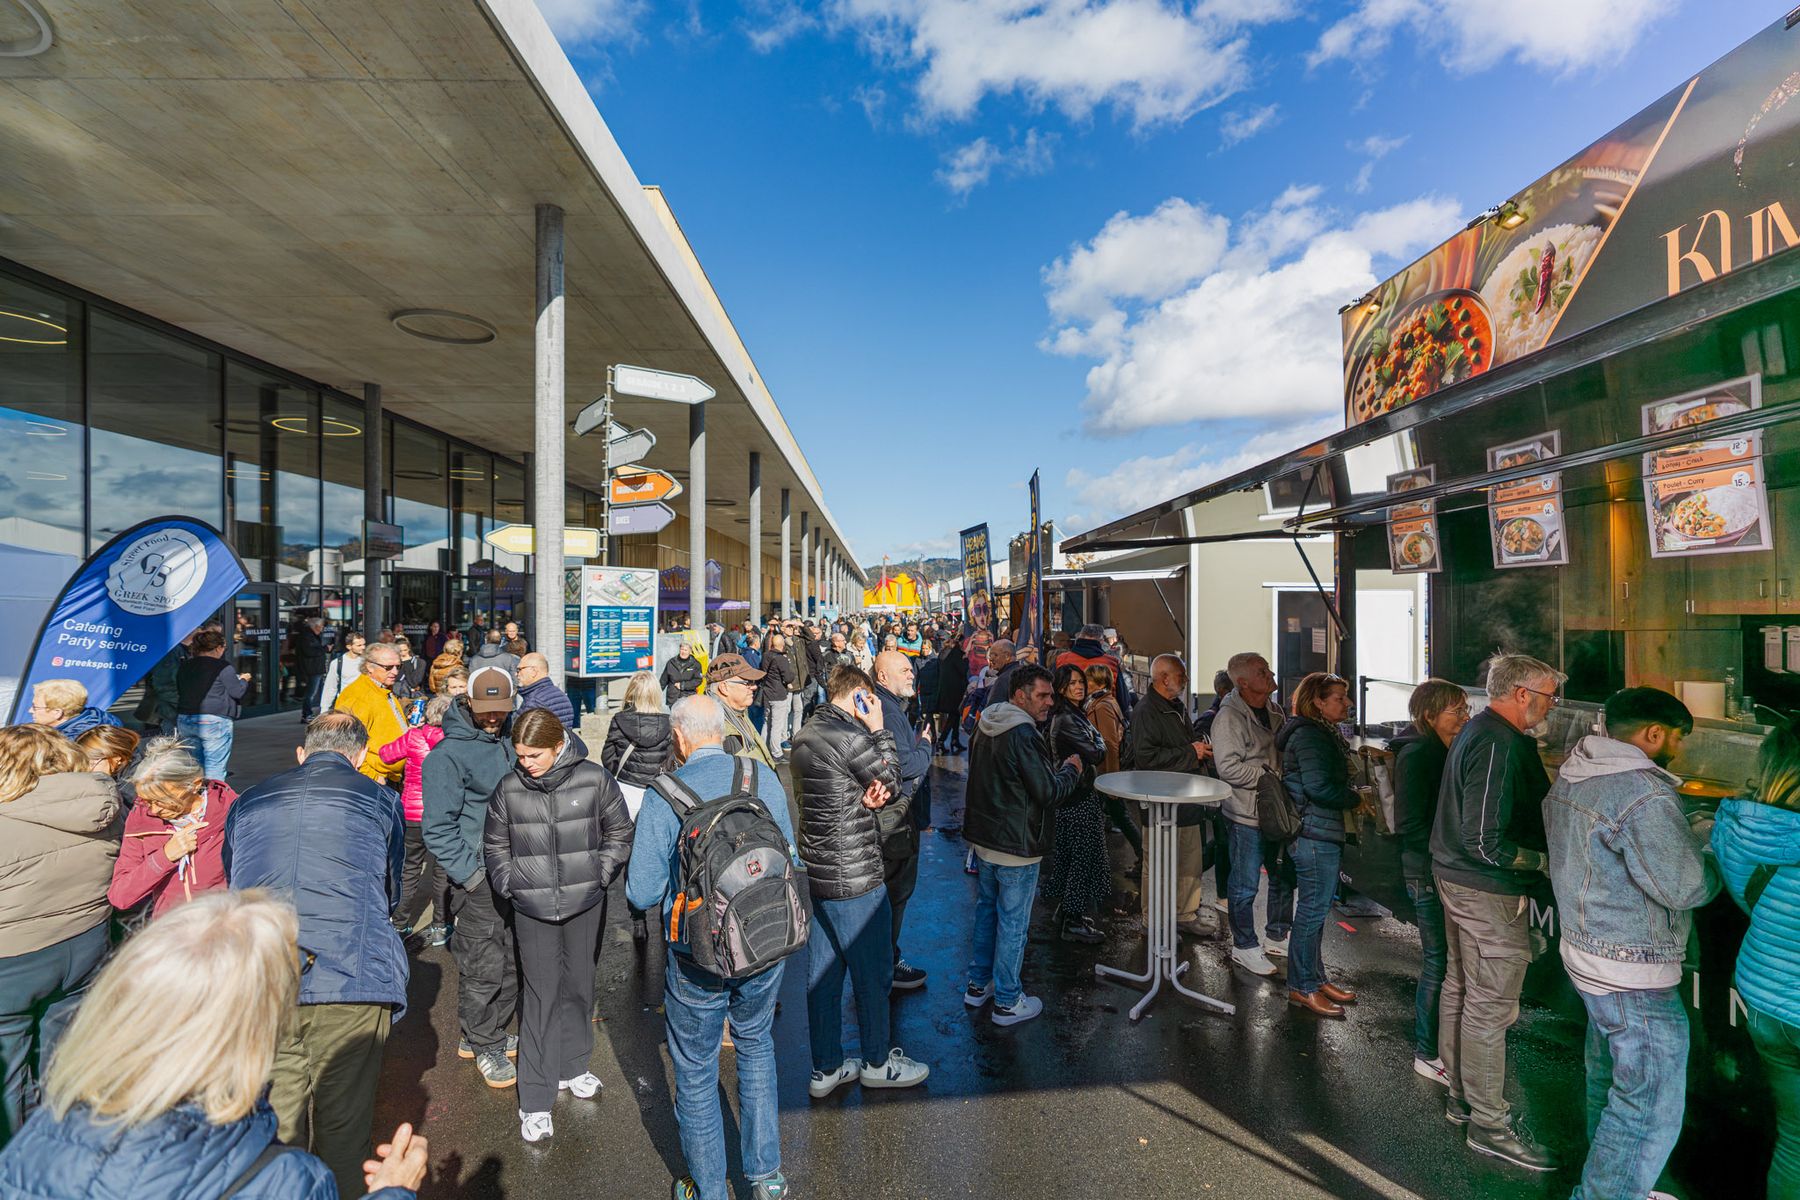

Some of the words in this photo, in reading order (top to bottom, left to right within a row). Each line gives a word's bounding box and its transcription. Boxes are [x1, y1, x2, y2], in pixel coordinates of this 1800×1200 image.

[1662, 480, 1682, 489] Poulet
[1688, 477, 1705, 486] Curry
[114, 589, 150, 602] GREEK
[153, 594, 178, 606] SPOT
[63, 618, 123, 637] Catering
[57, 633, 98, 650] Party
[99, 639, 148, 653] service
[63, 657, 128, 671] greekspot.ch
